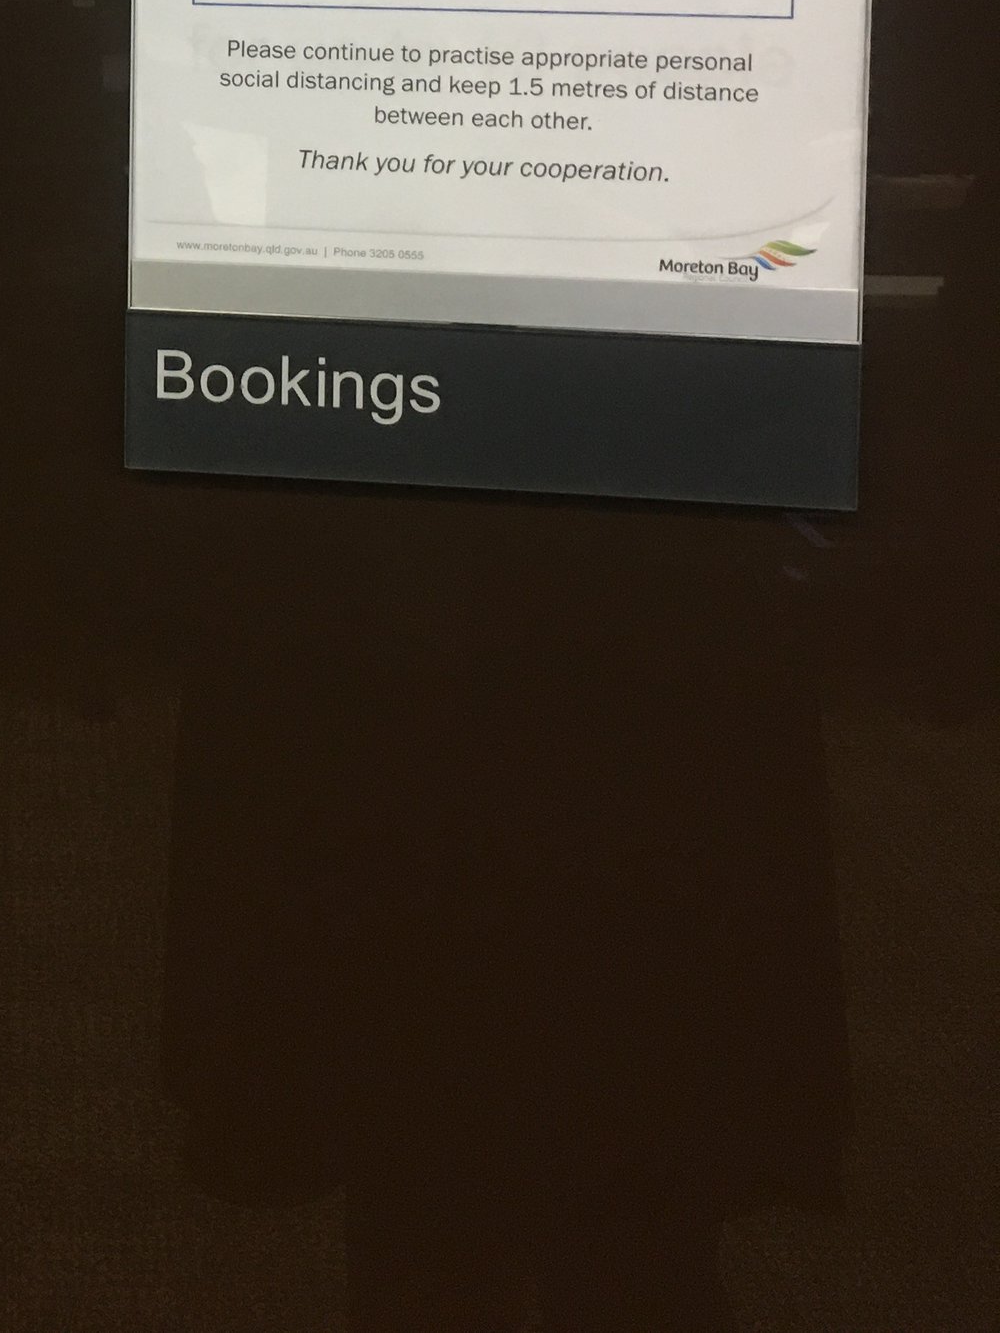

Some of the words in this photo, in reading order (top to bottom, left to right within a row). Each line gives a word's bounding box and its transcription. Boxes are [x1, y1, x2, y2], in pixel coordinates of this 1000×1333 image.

[226, 39, 296, 61] Please
[302, 42, 395, 63] continue
[400, 45, 422, 63] to
[428, 46, 515, 67] practise
[521, 51, 648, 72] appropriate
[655, 53, 753, 74] personal
[219, 70, 279, 88] social
[286, 70, 396, 96] distancing
[401, 75, 441, 93] and
[449, 75, 501, 99] keep
[509, 76, 544, 98] 1.5
[550, 78, 629, 100] metres
[634, 79, 657, 101] of
[662, 80, 759, 103] distance
[374, 105, 464, 127] between
[471, 109, 523, 129] each
[530, 111, 592, 131] other.
[299, 149, 369, 171] Thank
[373, 156, 416, 177] you
[423, 153, 456, 175] for
[459, 160, 514, 180] your
[519, 161, 669, 183] cooperation.
[176, 240, 318, 257] www.moretonbay.qld.gov.au
[332, 246, 367, 259] Phone
[369, 248, 395, 260] 3205
[397, 249, 425, 261] 0555
[658, 258, 724, 275] Moreton
[727, 260, 759, 282] Bay
[156, 349, 441, 425] Bookings
